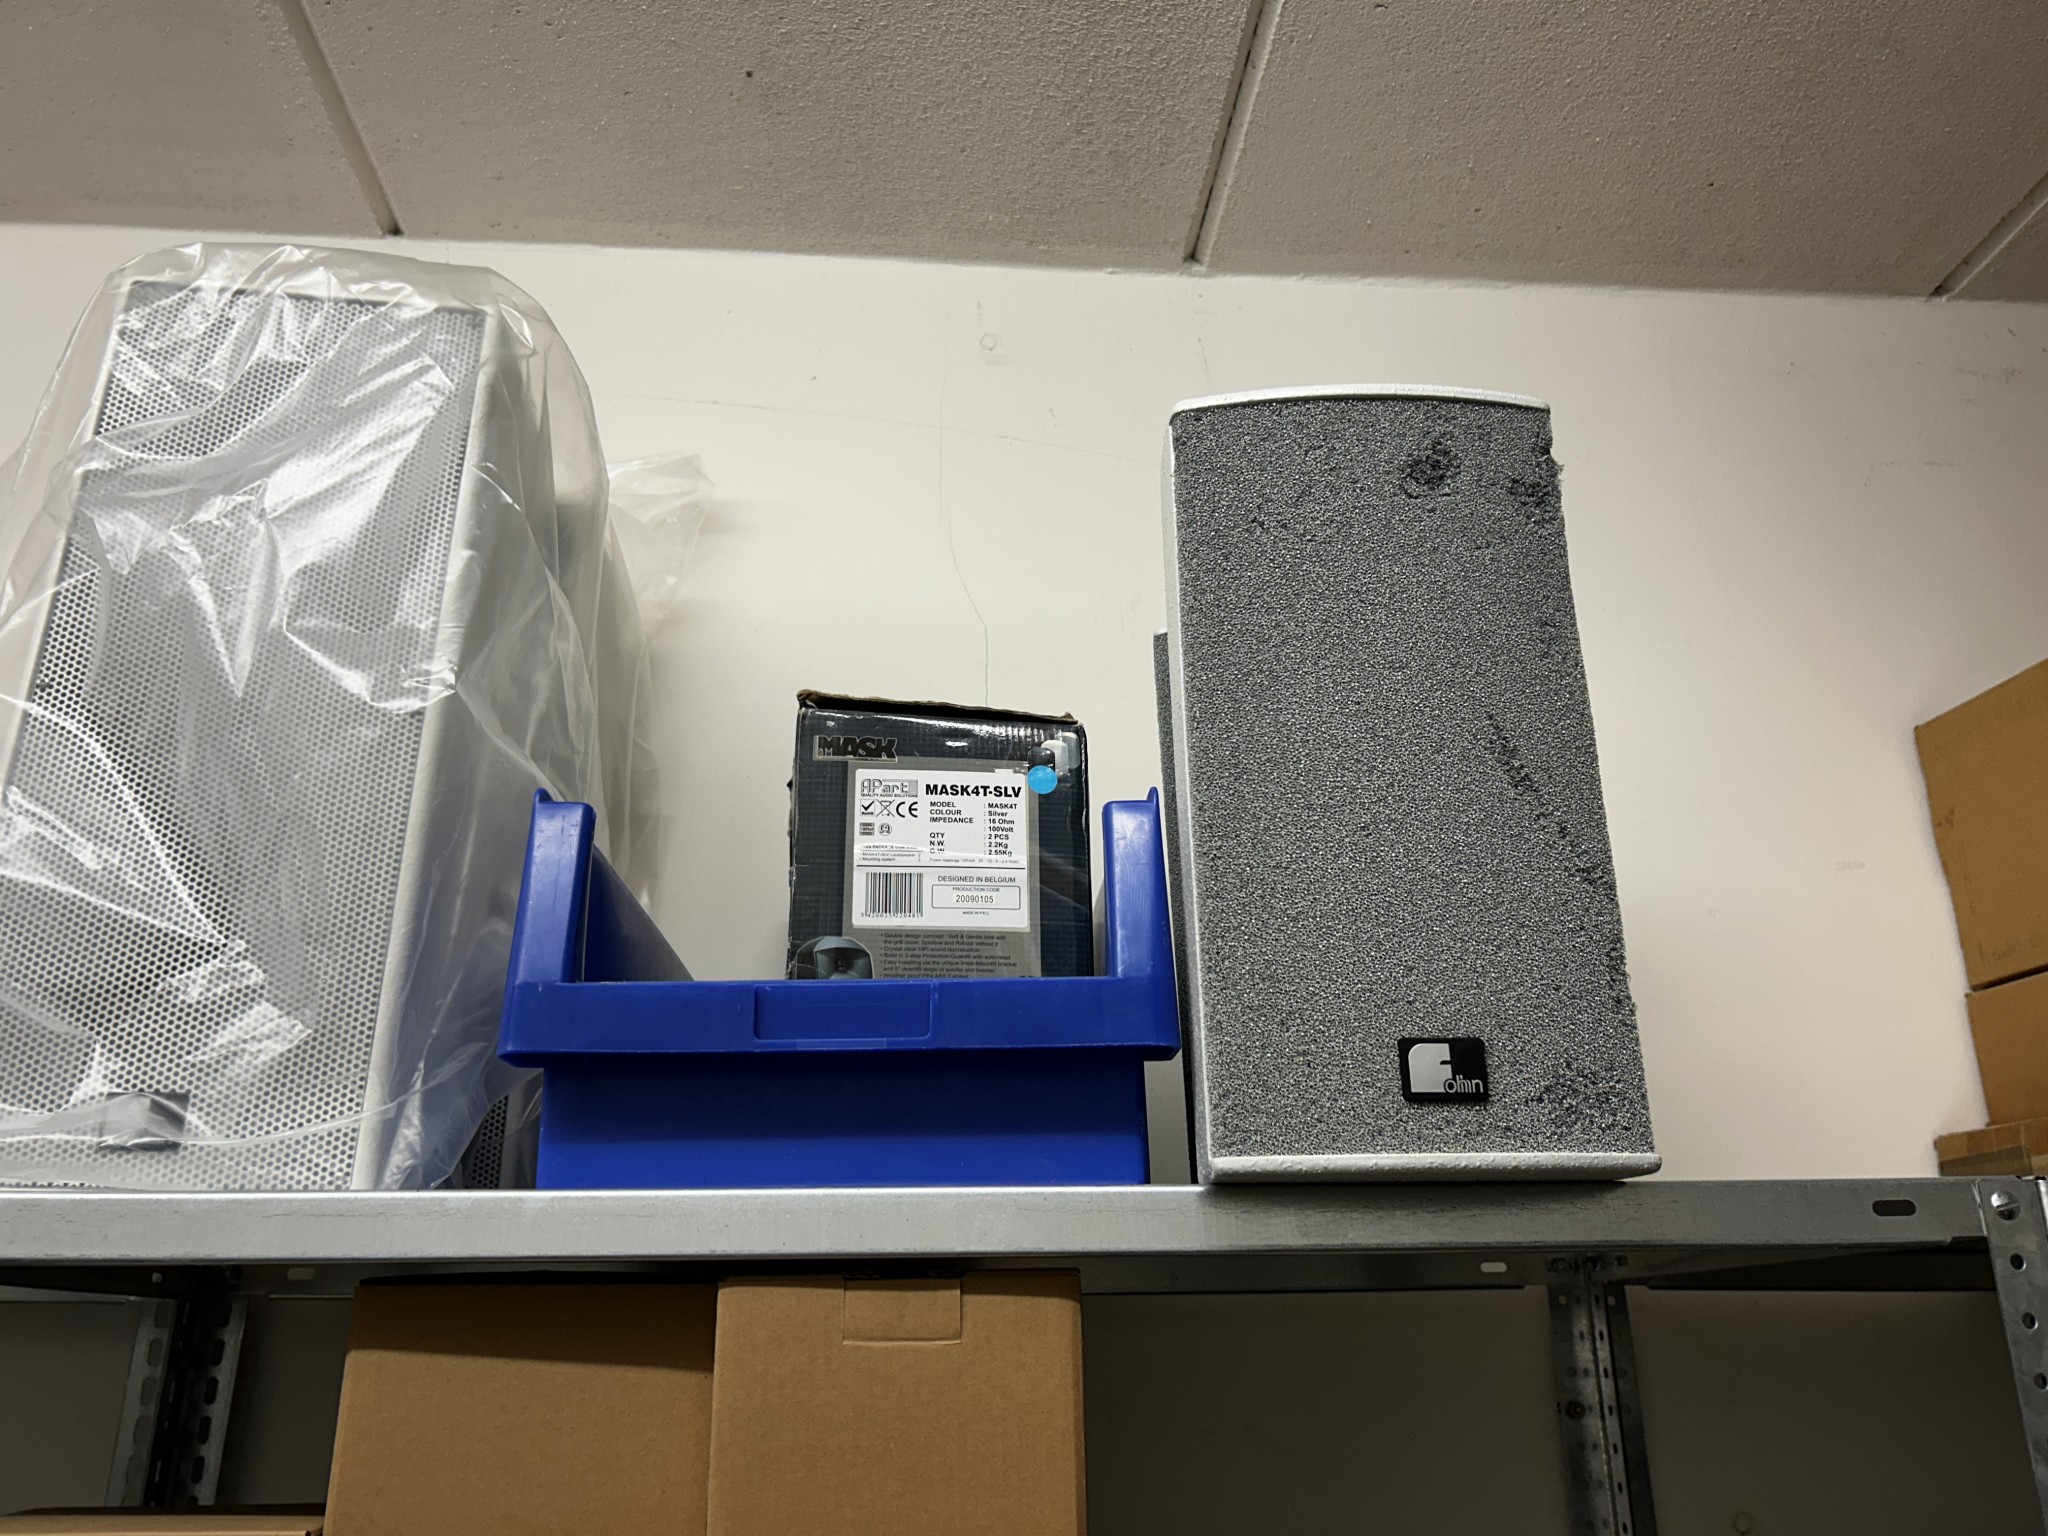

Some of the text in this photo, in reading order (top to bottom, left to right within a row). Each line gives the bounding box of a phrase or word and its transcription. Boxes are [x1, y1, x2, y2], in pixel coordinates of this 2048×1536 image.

[817, 735, 897, 758] MASK
[925, 783, 1022, 798] MASK4T-SLV
[988, 849, 1012, 857] 2.55Kg
[955, 894, 994, 904] 20090105
